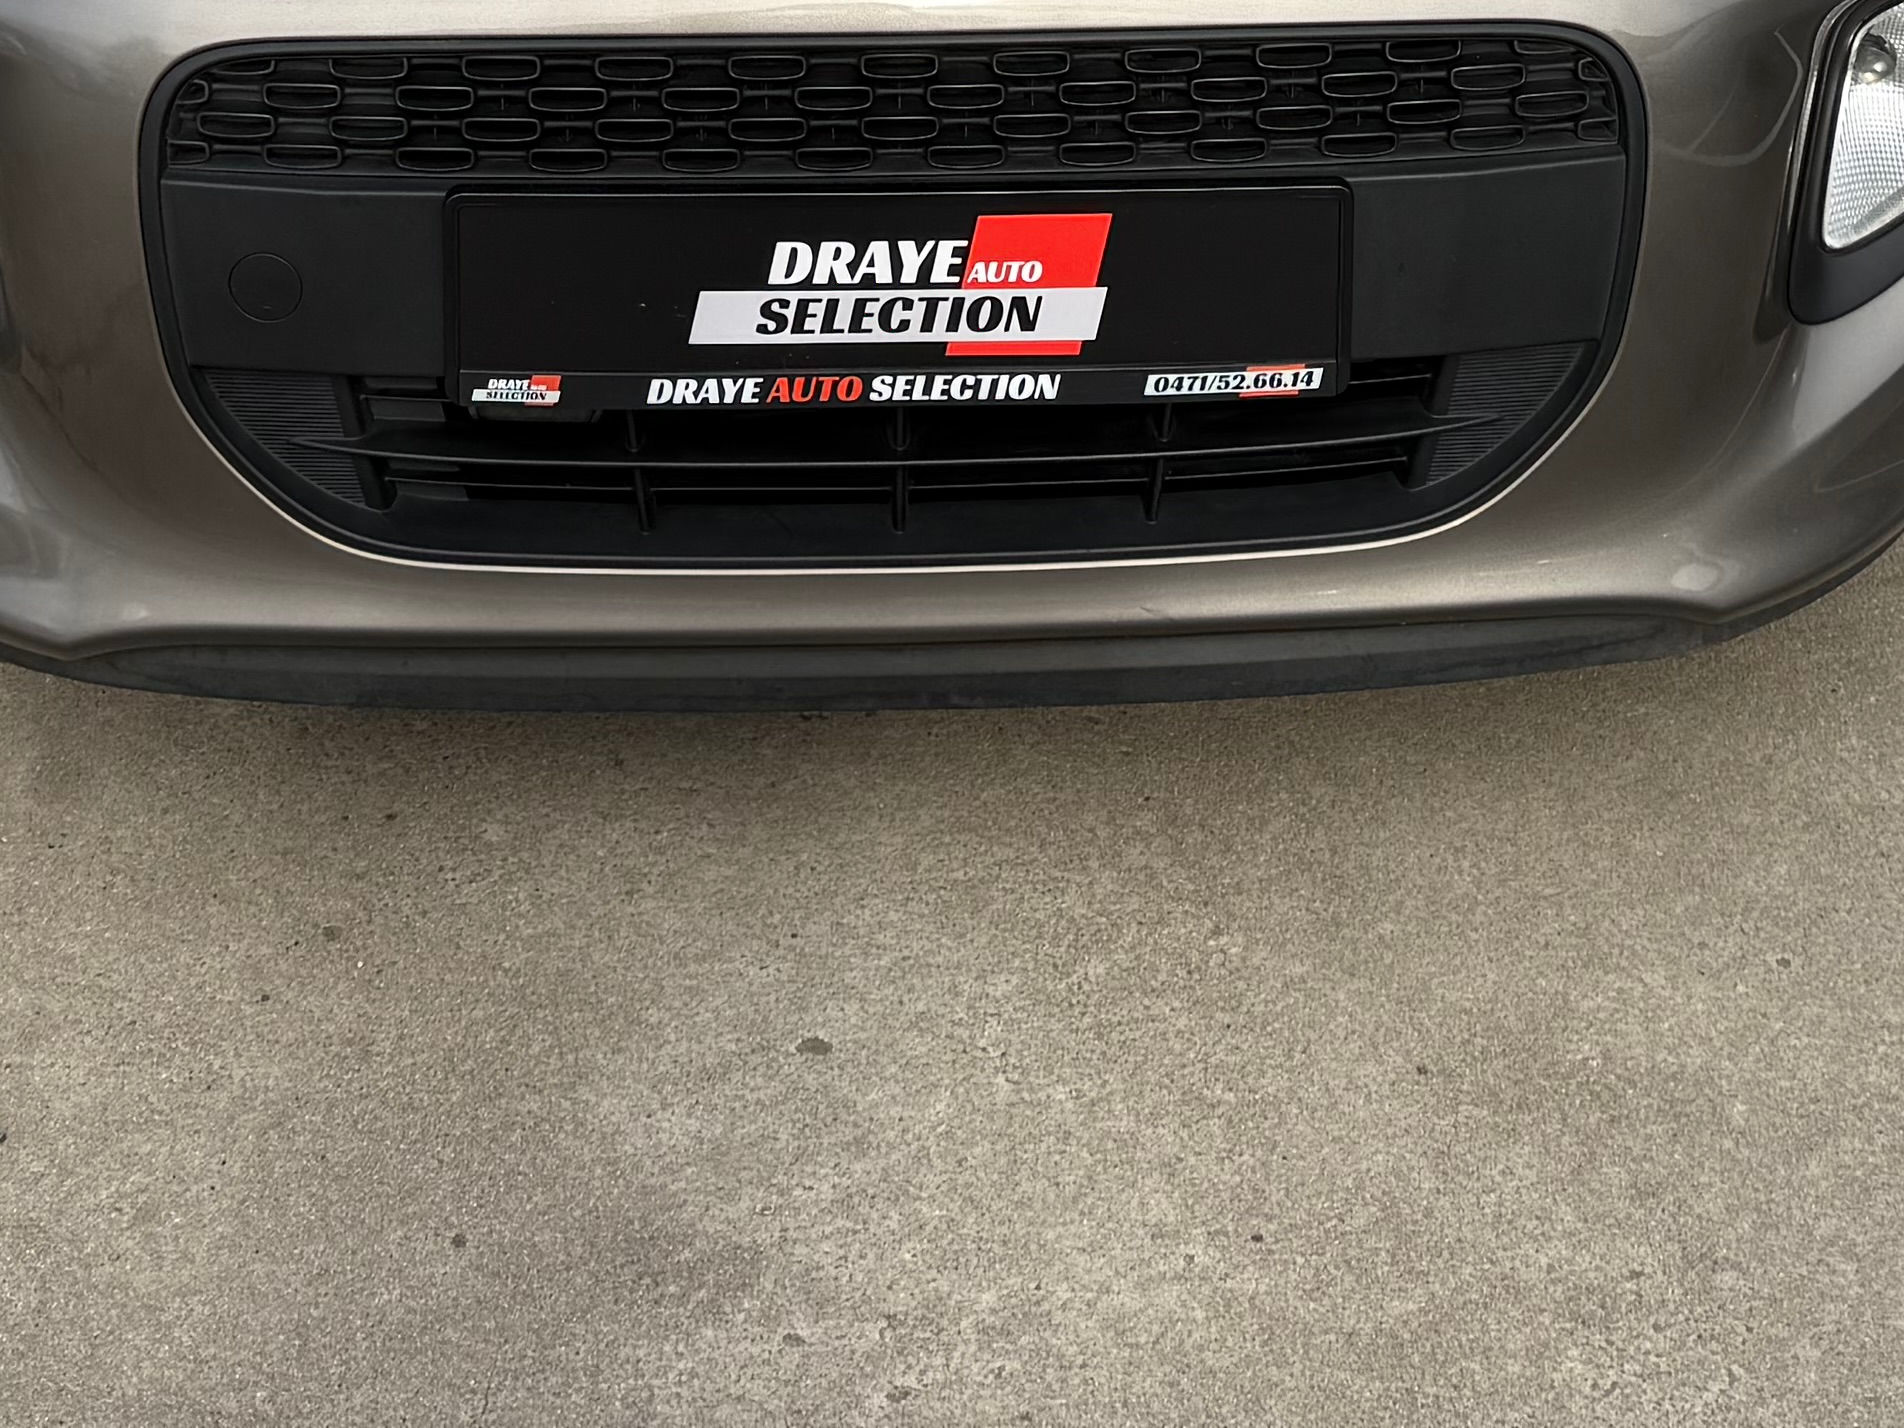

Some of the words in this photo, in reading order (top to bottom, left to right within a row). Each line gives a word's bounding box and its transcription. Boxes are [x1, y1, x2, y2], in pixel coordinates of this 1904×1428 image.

[767, 240, 969, 285] DRAYE
[967, 260, 1043, 283] AUTO
[755, 295, 1043, 335] SELECTION
[646, 377, 764, 404] DRAYE
[767, 375, 863, 402] AUTO
[869, 374, 1061, 401] SELECTION
[1154, 370, 1314, 393] 0471/52.66.14
